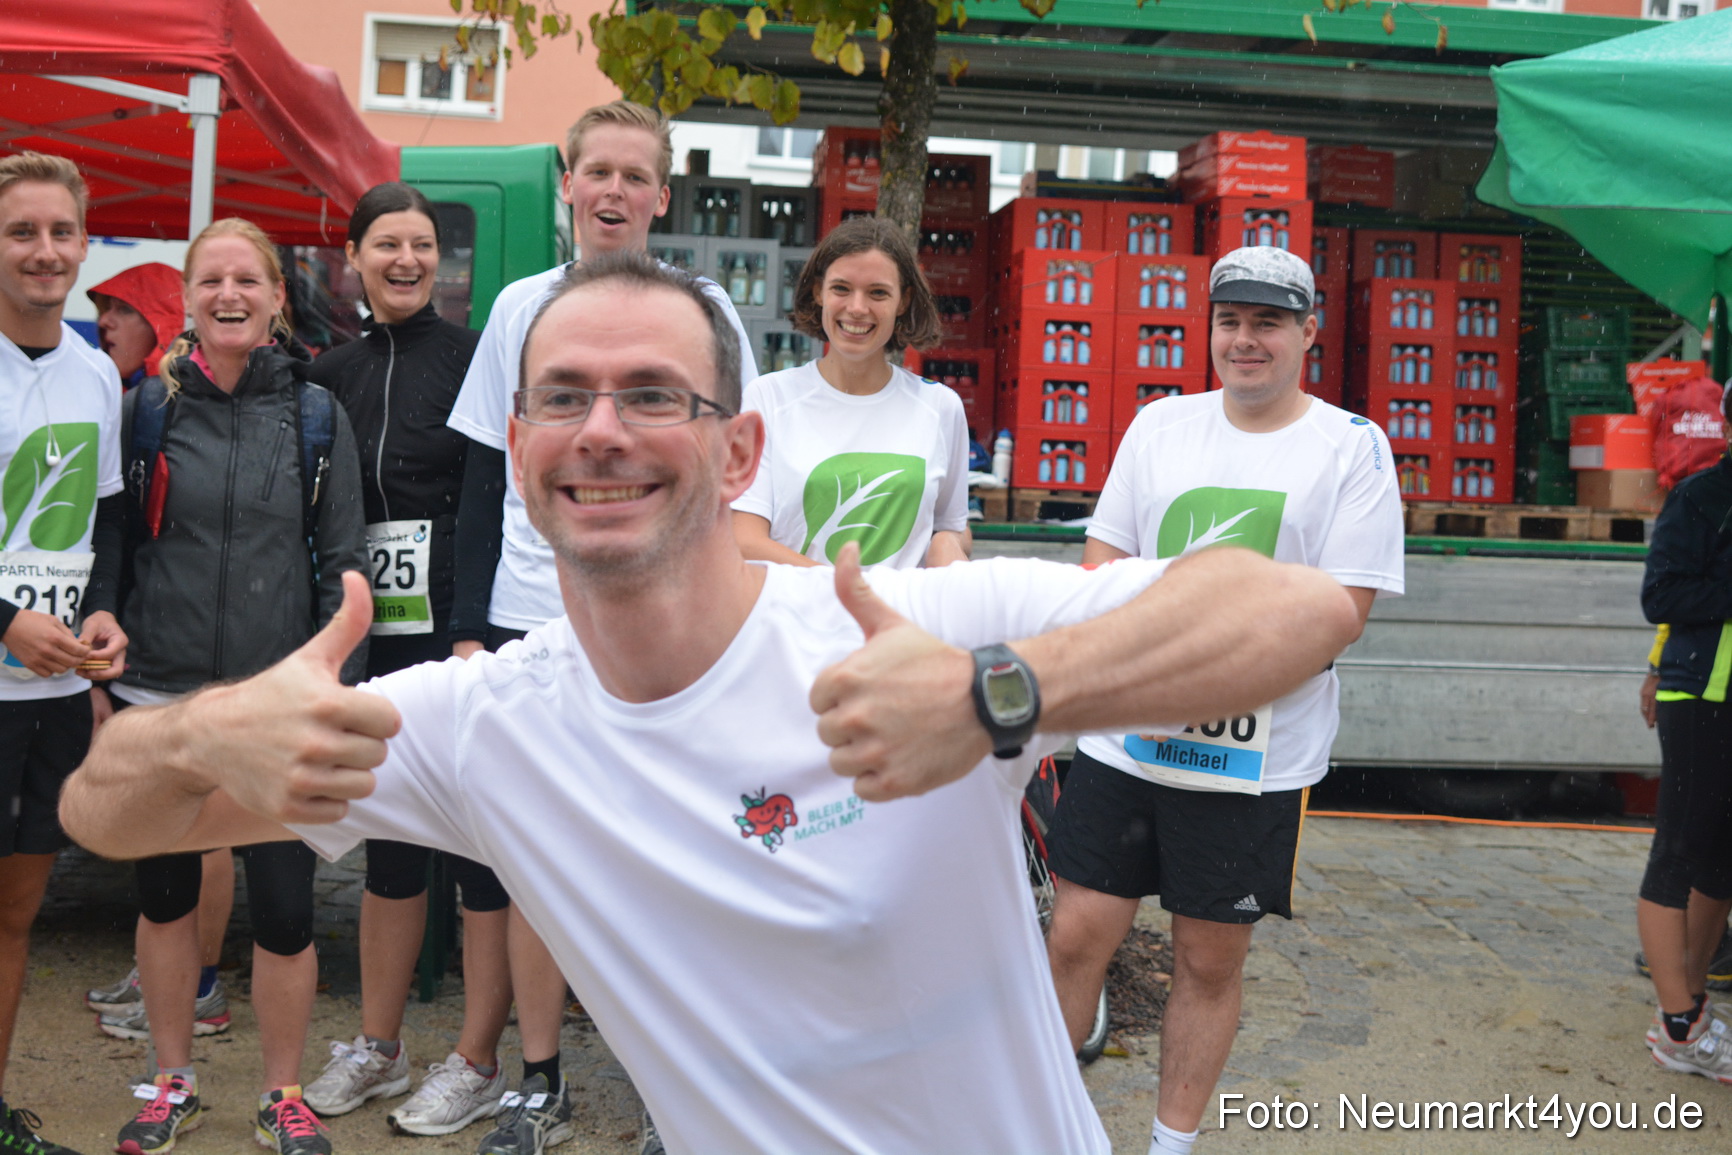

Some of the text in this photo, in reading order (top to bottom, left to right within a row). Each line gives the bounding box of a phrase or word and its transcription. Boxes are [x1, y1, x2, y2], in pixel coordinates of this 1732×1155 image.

[373, 549, 415, 589] 25
[1155, 742, 1228, 771] Michael
[808, 801, 844, 822] BLEIB
[794, 818, 836, 841] MACH
[1233, 903, 1261, 912] adidas
